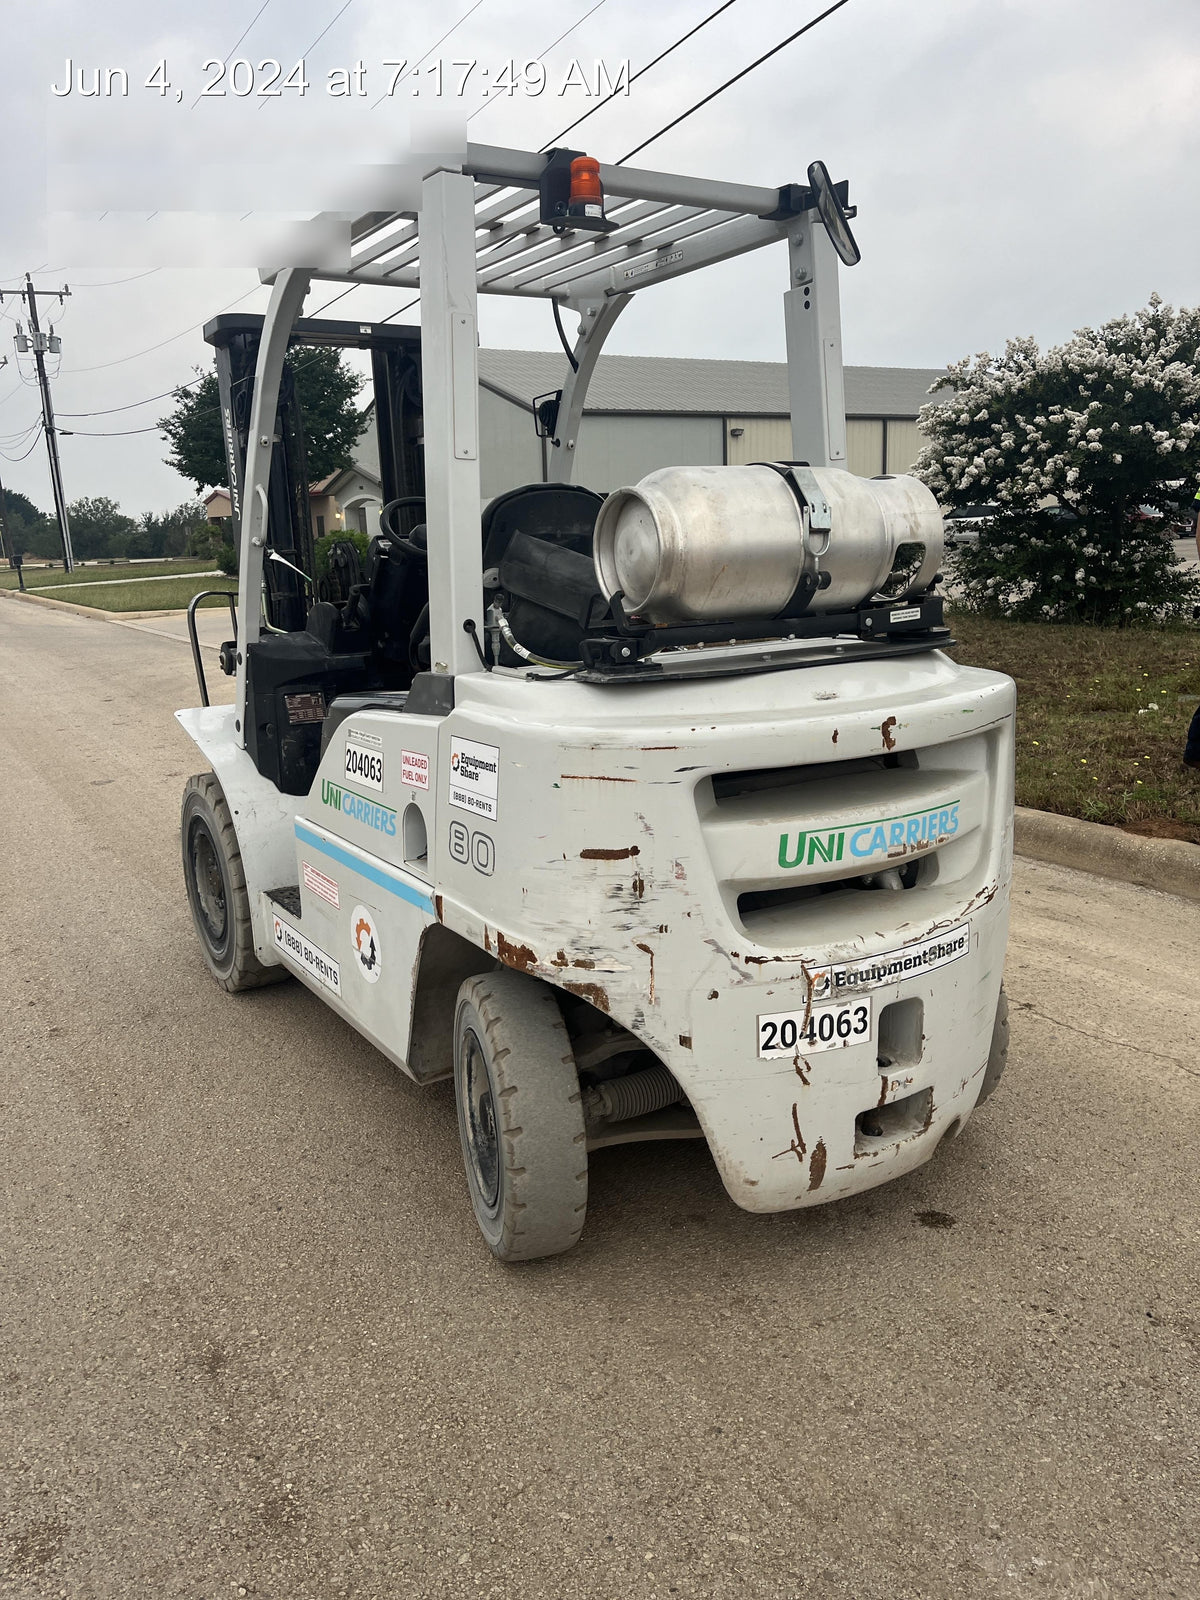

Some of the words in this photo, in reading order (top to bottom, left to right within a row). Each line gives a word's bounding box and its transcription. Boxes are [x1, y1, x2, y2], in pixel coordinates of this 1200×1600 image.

[346, 748, 382, 783] 204063
[402, 754, 428, 770] UNLEADED
[402, 769, 415, 781] FUEL
[415, 772, 427, 785] ONLY
[460, 752, 497, 774] Equipment
[460, 765, 480, 781] Share
[322, 778, 397, 837] UNICARRIERS
[448, 820, 496, 877] 80
[777, 804, 960, 869] UNICARRIERS
[284, 930, 303, 957] (888)
[304, 946, 339, 985] 80-RENTS
[834, 936, 965, 988] EquipmentShare
[760, 1005, 869, 1051] 204063
